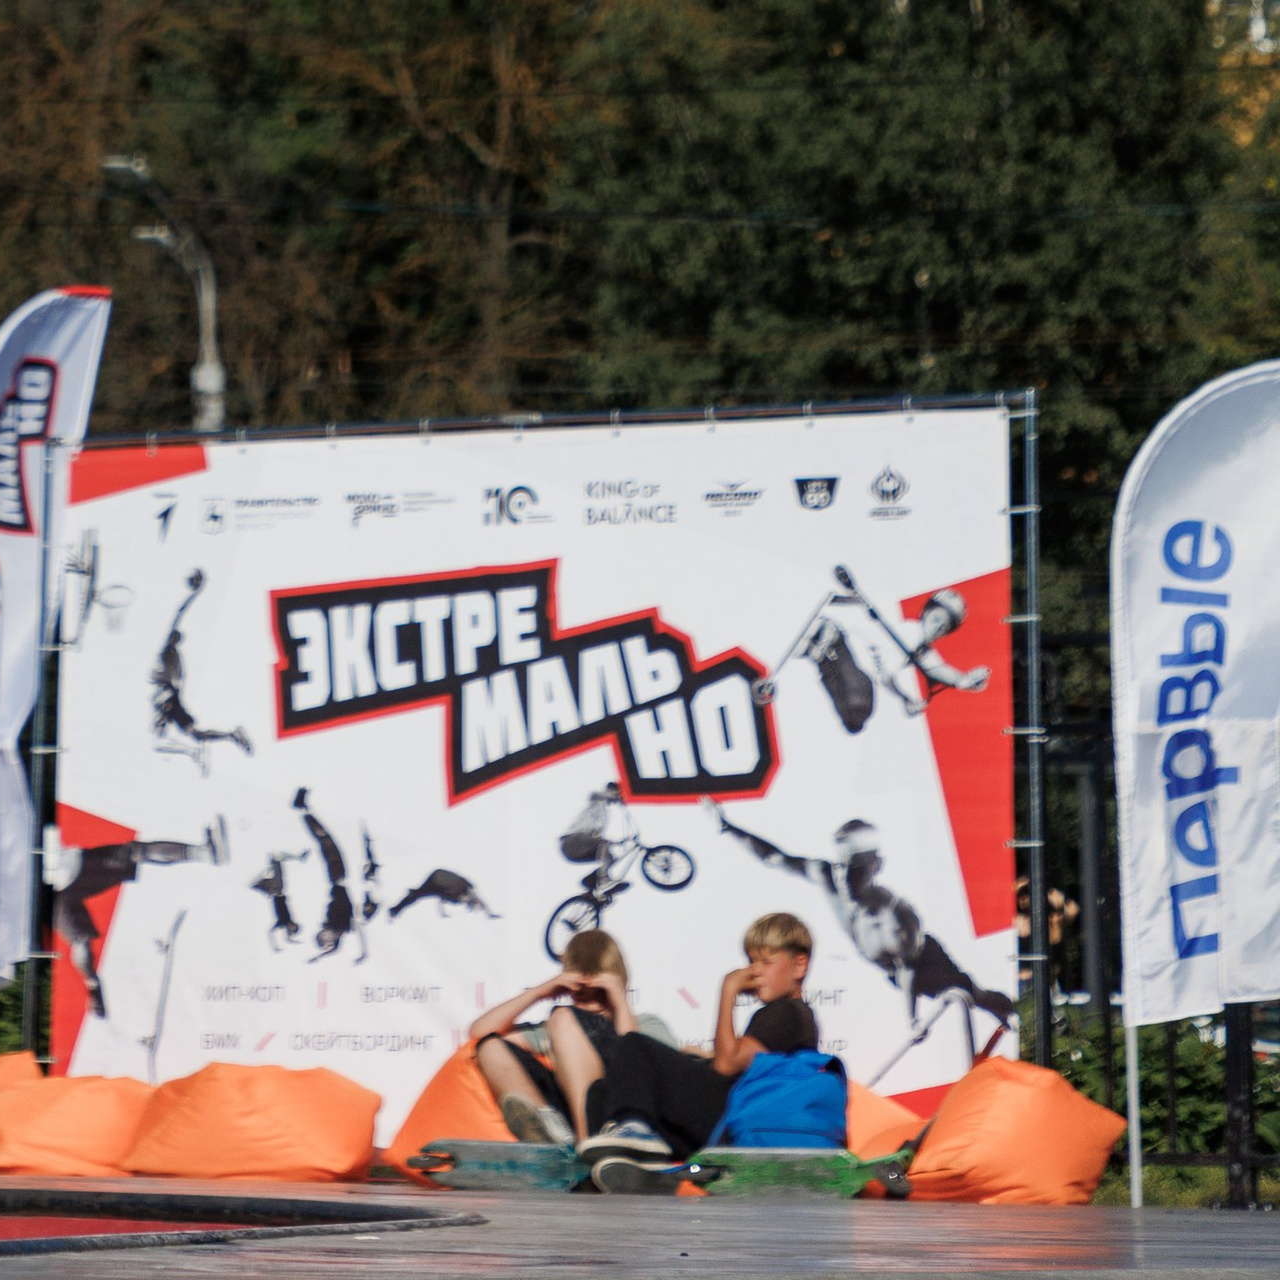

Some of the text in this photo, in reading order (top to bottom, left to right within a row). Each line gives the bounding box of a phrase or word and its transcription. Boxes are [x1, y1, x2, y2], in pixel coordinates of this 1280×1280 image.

[585, 480, 637, 499] KING
[585, 504, 677, 525] BALANCE
[286, 586, 541, 712] ЭКСТРЕ
[461, 635, 682, 773] МАЛЬ
[625, 674, 760, 779] НО
